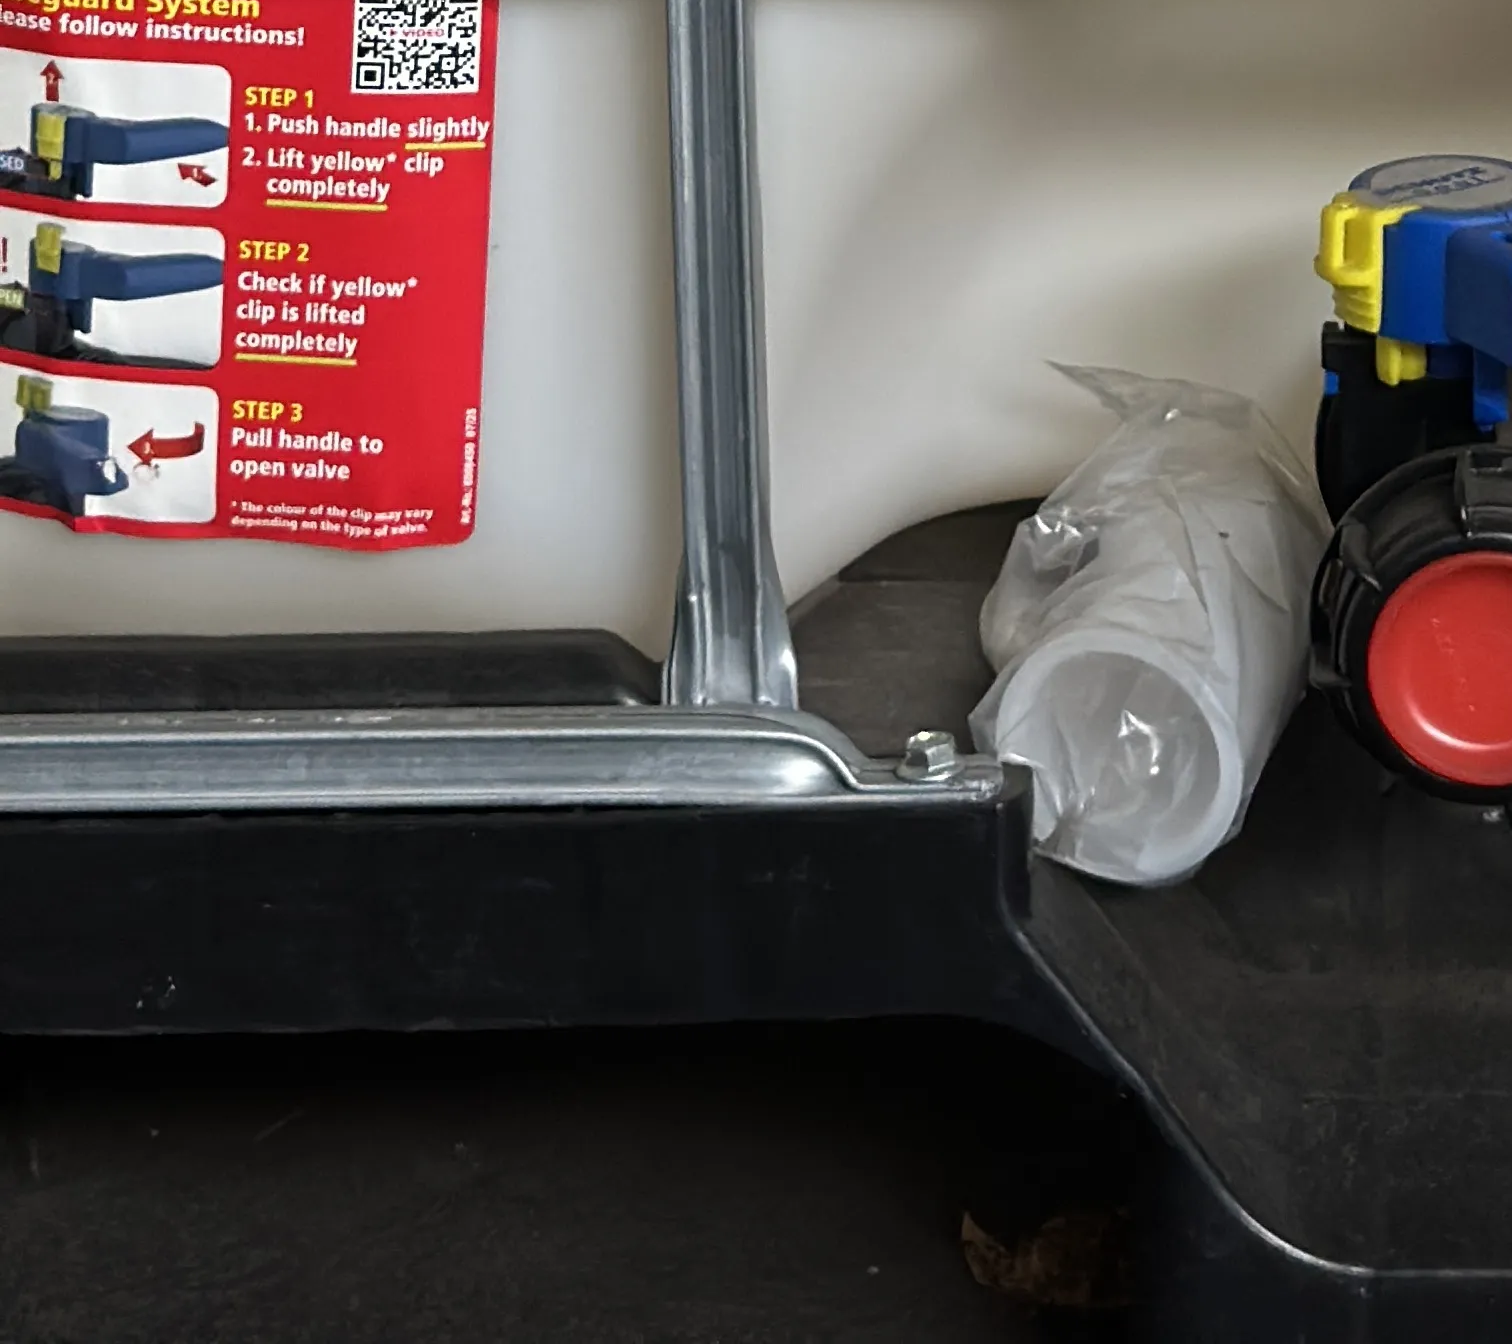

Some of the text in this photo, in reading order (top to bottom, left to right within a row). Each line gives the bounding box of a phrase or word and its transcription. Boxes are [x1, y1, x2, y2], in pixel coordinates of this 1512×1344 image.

[59, 13, 138, 38] follow
[146, 20, 304, 46] instructions!
[403, 29, 444, 37] VIDEO
[245, 87, 313, 108] STEP 1
[245, 112, 490, 142] 1. Push handle slightly
[242, 147, 261, 167] 2.
[268, 148, 304, 168] Lift
[404, 153, 444, 177] clip
[266, 176, 390, 202] completely
[239, 240, 309, 262] STEP 2
[238, 271, 302, 294] Check
[309, 275, 325, 294] if
[236, 300, 365, 325] clip is lifted
[235, 330, 357, 357] completely
[233, 400, 303, 422] STEP 3
[231, 427, 384, 454] Pull handle to
[230, 459, 350, 480] open valve
[241, 501, 263, 512] The
[310, 504, 323, 515] of
[327, 505, 347, 517] the
[351, 508, 372, 521] clip
[231, 515, 297, 531] depending
[325, 518, 343, 533] the
[344, 522, 372, 537] type
